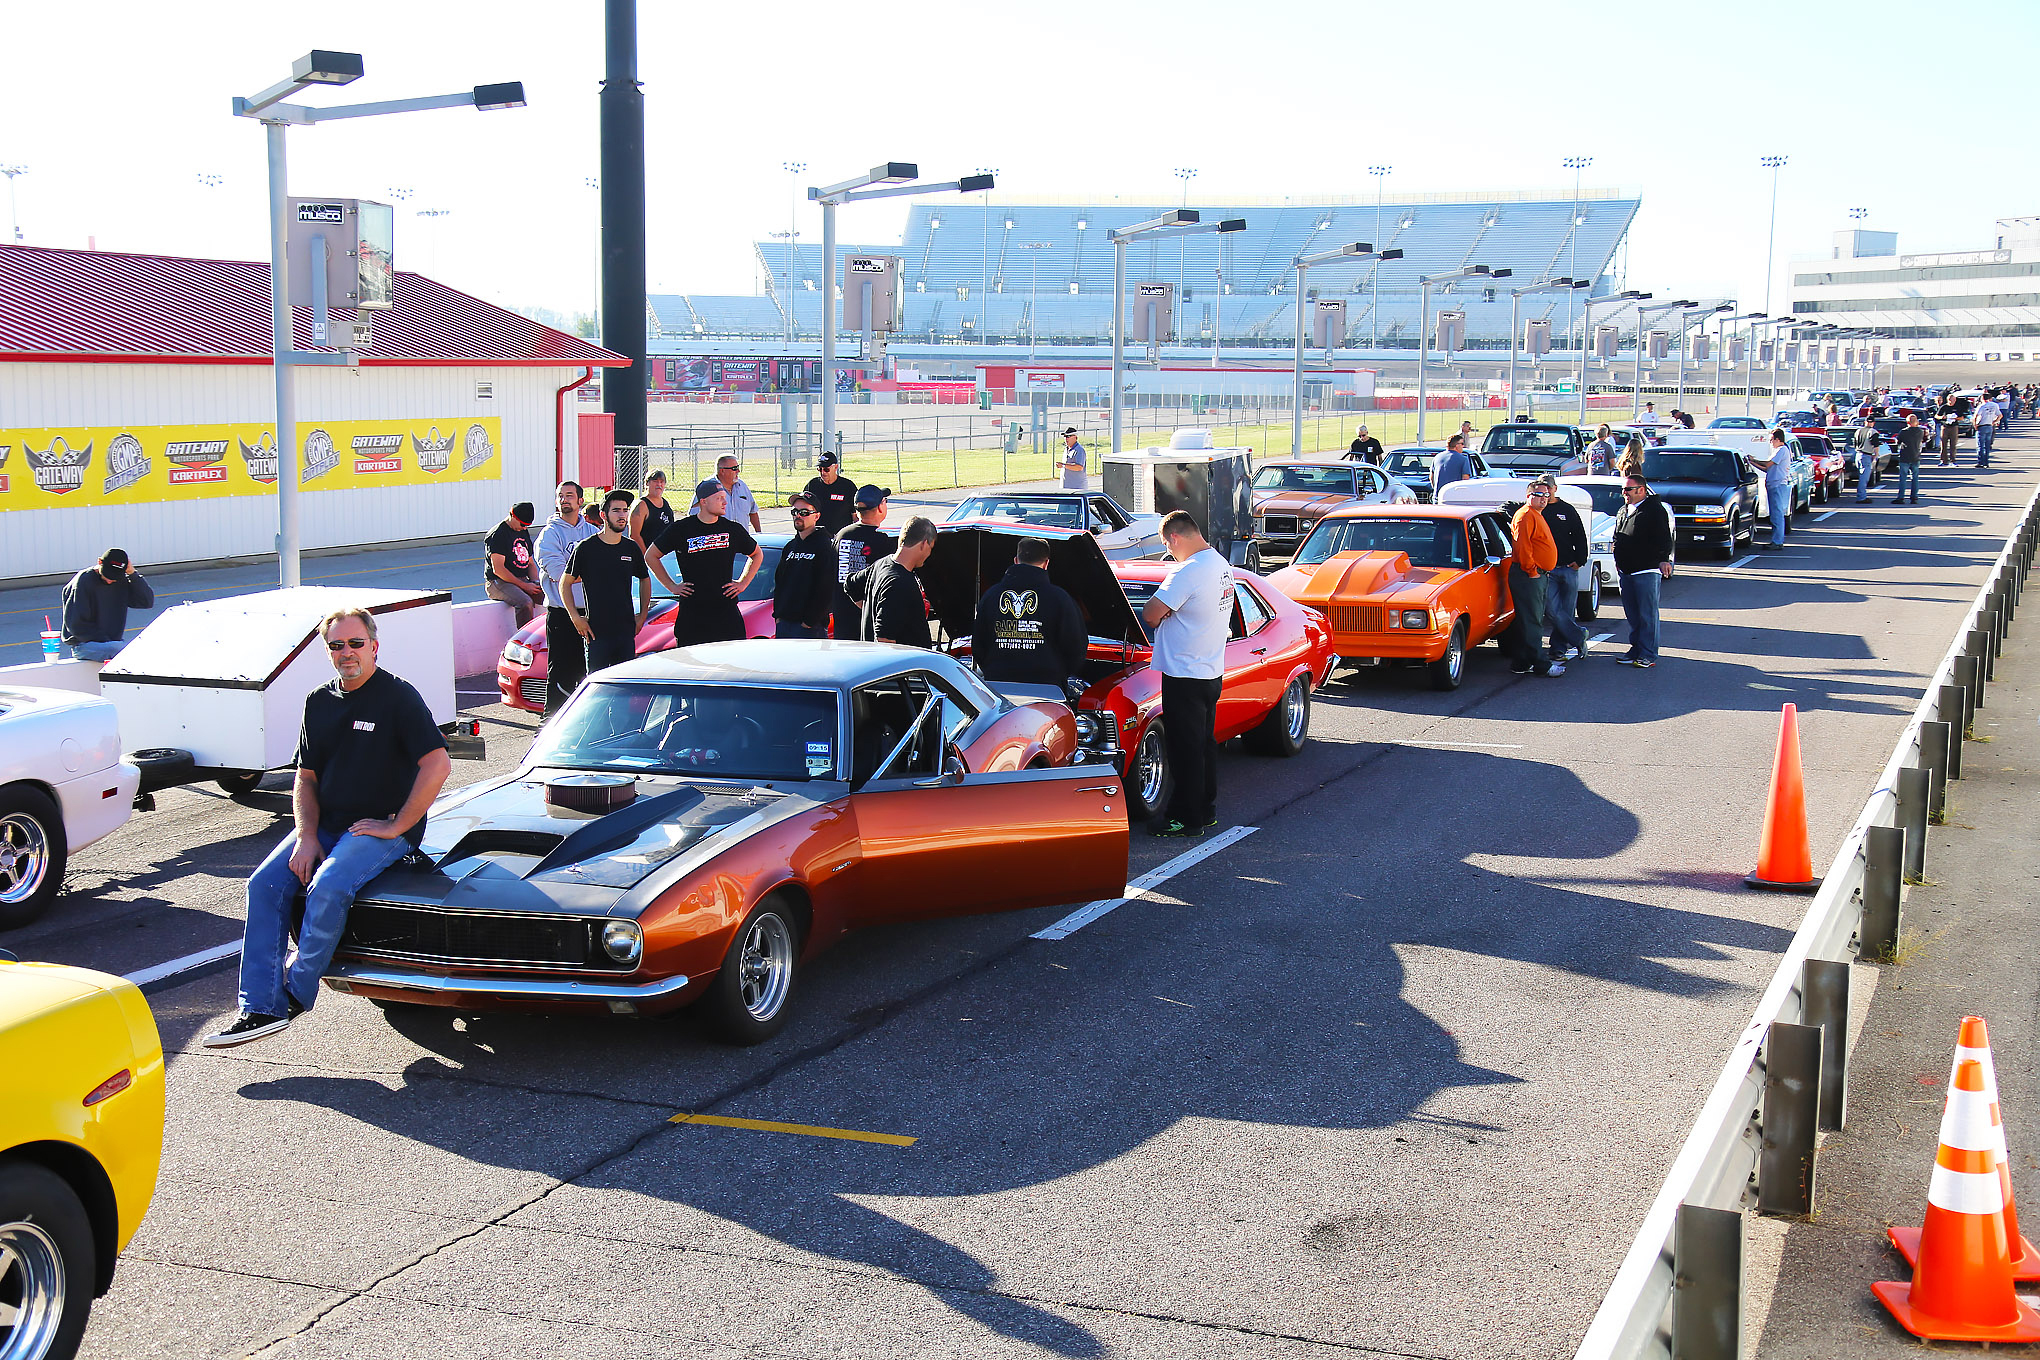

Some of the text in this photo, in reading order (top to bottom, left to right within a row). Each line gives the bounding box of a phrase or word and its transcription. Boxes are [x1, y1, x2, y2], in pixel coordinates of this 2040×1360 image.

[299, 210, 342, 221] musco
[164, 440, 228, 456] GATEWAY
[351, 434, 403, 448] GATEWAY
[117, 444, 138, 471] GMP
[312, 437, 329, 464] GMP
[418, 450, 450, 466] GATEWAY
[247, 457, 277, 476] GATEW
[357, 461, 398, 471] KARTPLEX
[35, 465, 84, 485] GATEWAY
[105, 460, 151, 491] DIRTPLEX
[172, 469, 222, 481] KARTPLEX
[838, 539, 851, 583] CROWER
[352, 720, 364, 730] HOT
